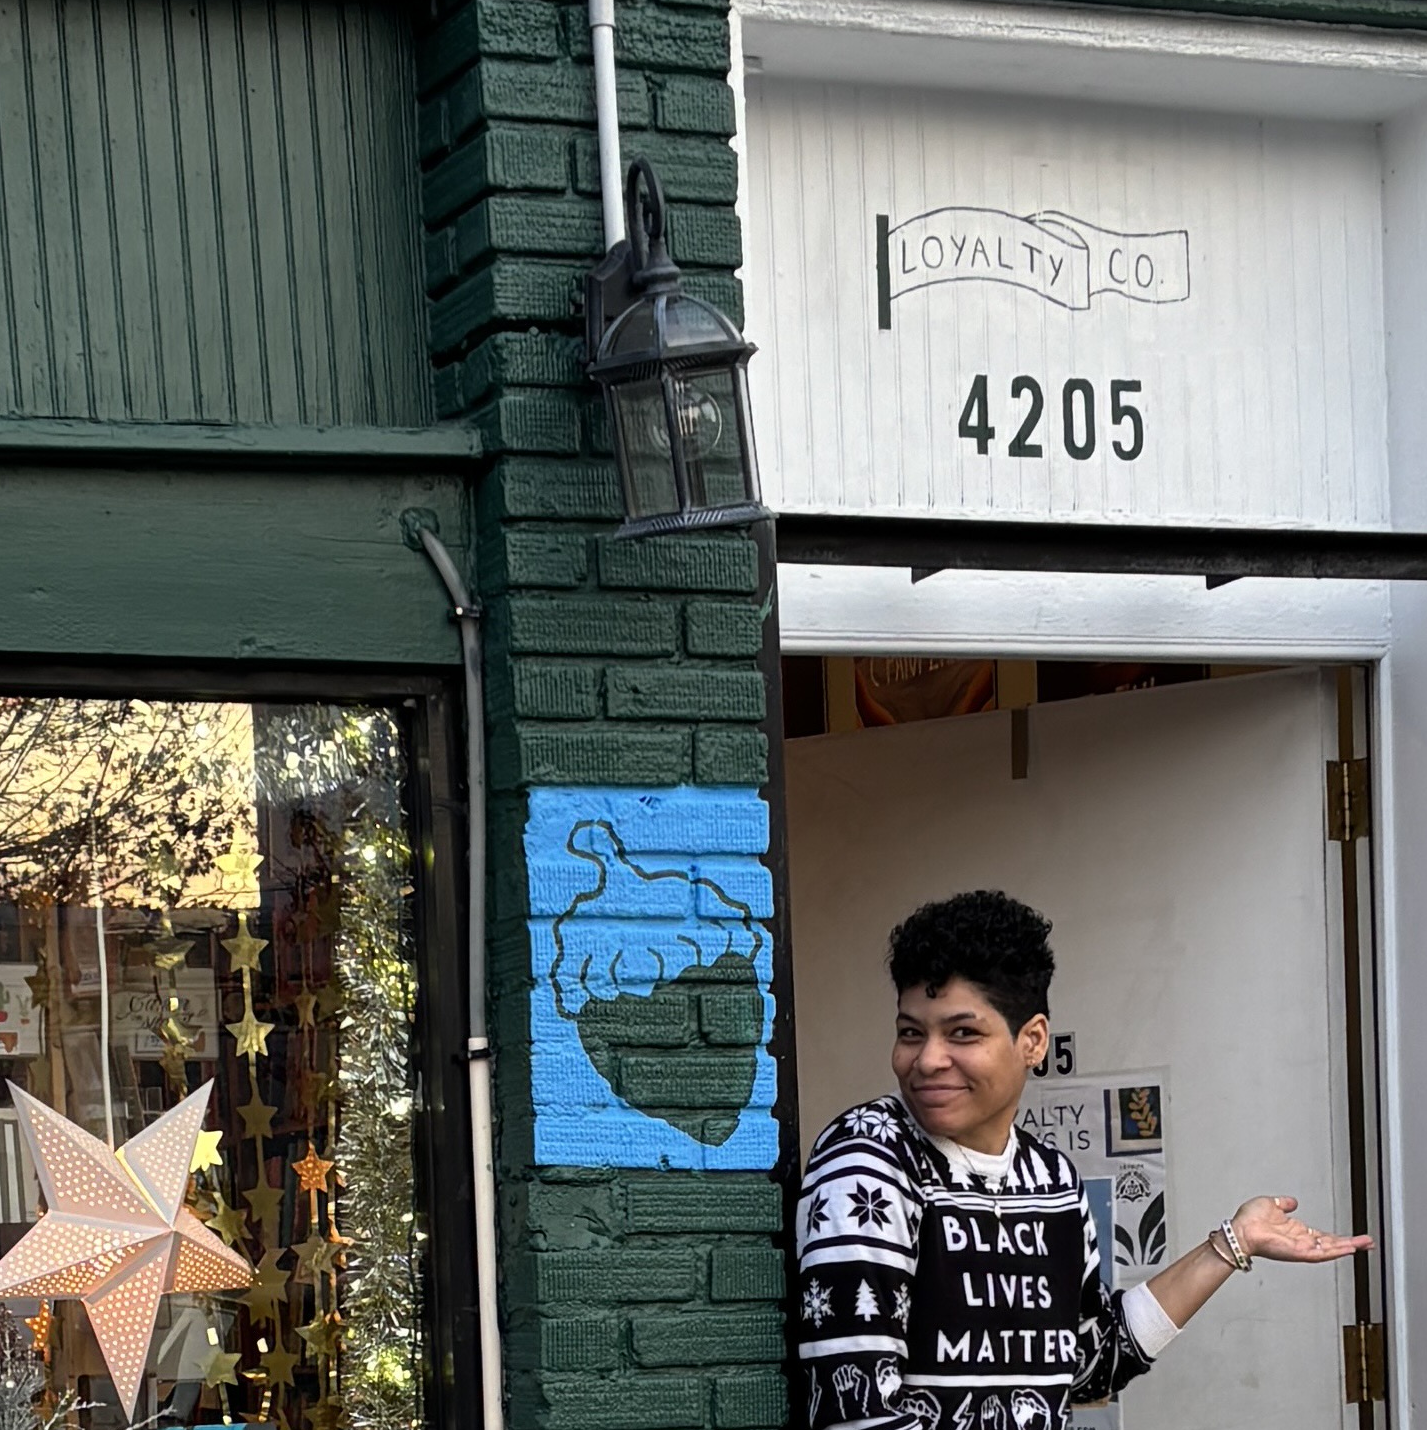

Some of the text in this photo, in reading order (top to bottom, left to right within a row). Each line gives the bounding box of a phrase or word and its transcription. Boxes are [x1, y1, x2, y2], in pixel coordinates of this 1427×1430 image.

[901, 234, 1165, 289] LOYALTY CO.
[957, 374, 1144, 461] 4205
[945, 1215, 1050, 1258] BLACK
[961, 1272, 1053, 1310] LIVES
[936, 1328, 1077, 1364] MATTER
